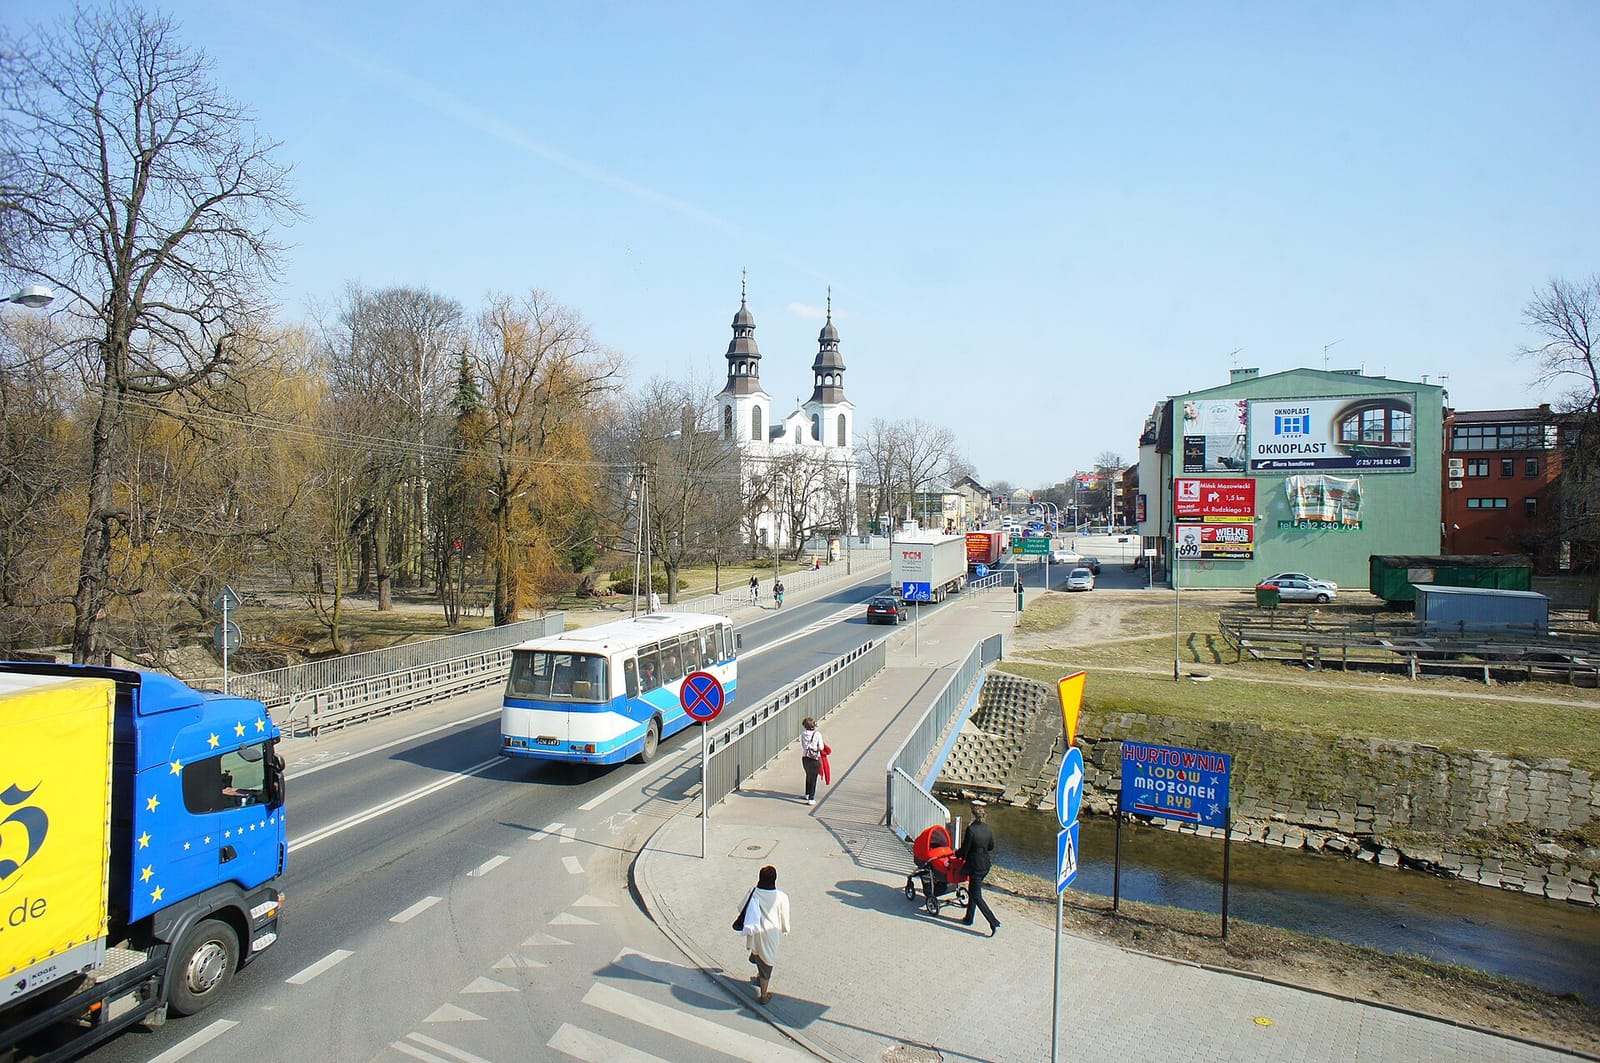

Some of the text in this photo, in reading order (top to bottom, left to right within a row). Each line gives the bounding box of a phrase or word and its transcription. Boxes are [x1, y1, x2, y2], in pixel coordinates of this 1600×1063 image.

[1258, 443, 1327, 454] OKNOPLAST
[1320, 522, 1338, 530] 340
[1216, 528, 1248, 536] WIELKIE
[1124, 744, 1226, 774] HURTOWNIA
[1167, 795, 1192, 809] RYB
